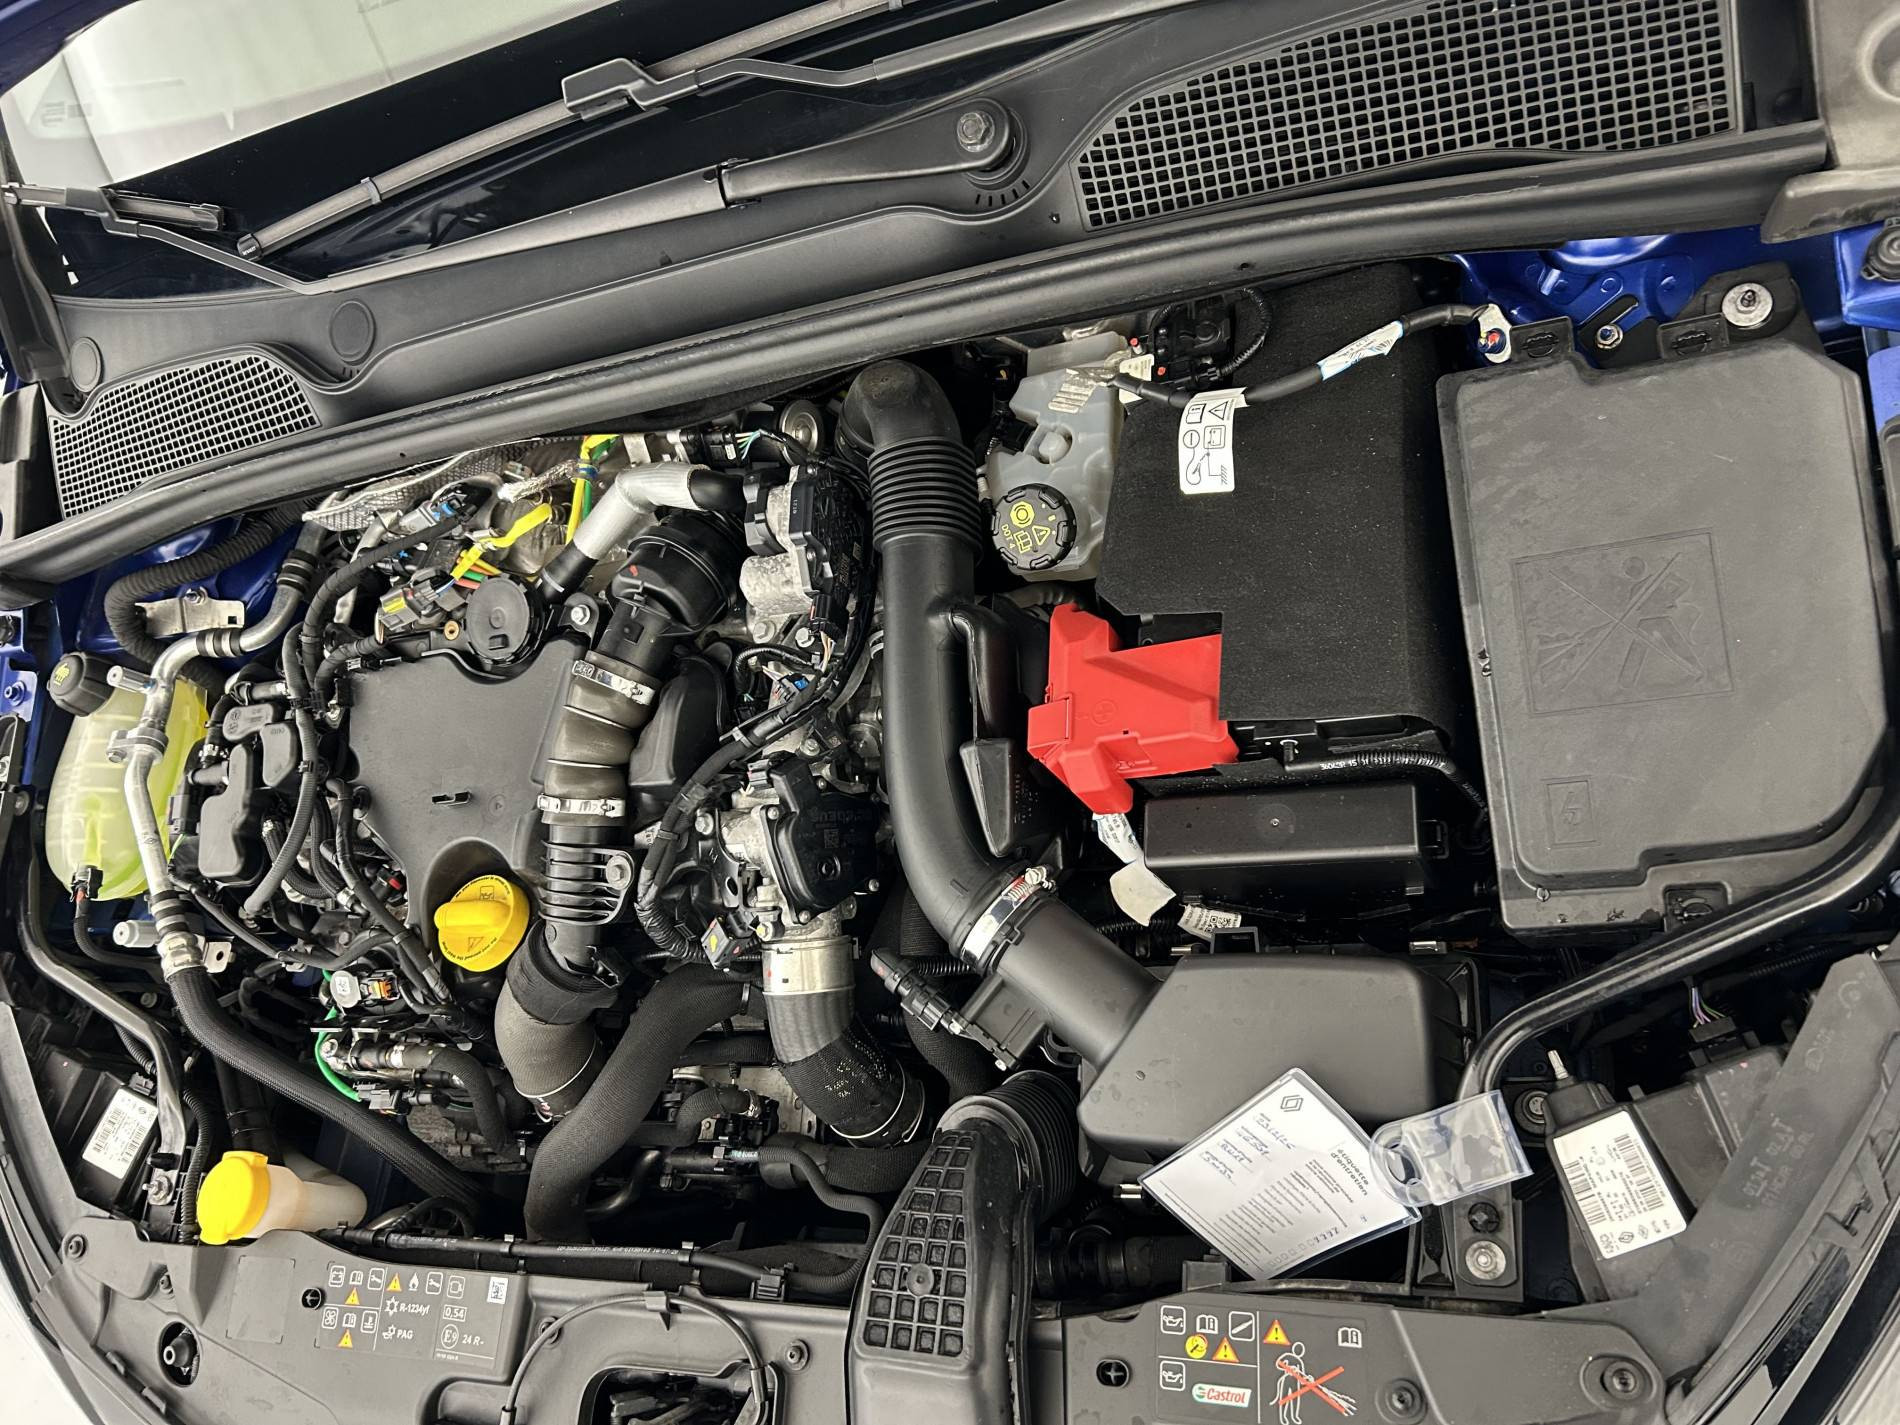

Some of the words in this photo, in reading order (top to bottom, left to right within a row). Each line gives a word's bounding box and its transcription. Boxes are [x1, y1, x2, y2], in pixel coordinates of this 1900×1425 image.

[1001, 523, 1014, 541] DOT
[1330, 1152, 1368, 1196] d'entretien
[1337, 1149, 1369, 1185] étiquette
[399, 1302, 430, 1316] R-1234yf
[445, 1307, 464, 1319] 0,54
[397, 1329, 414, 1340] PAG
[462, 1334, 472, 1345] 24
[1207, 1387, 1246, 1404] Castrol
